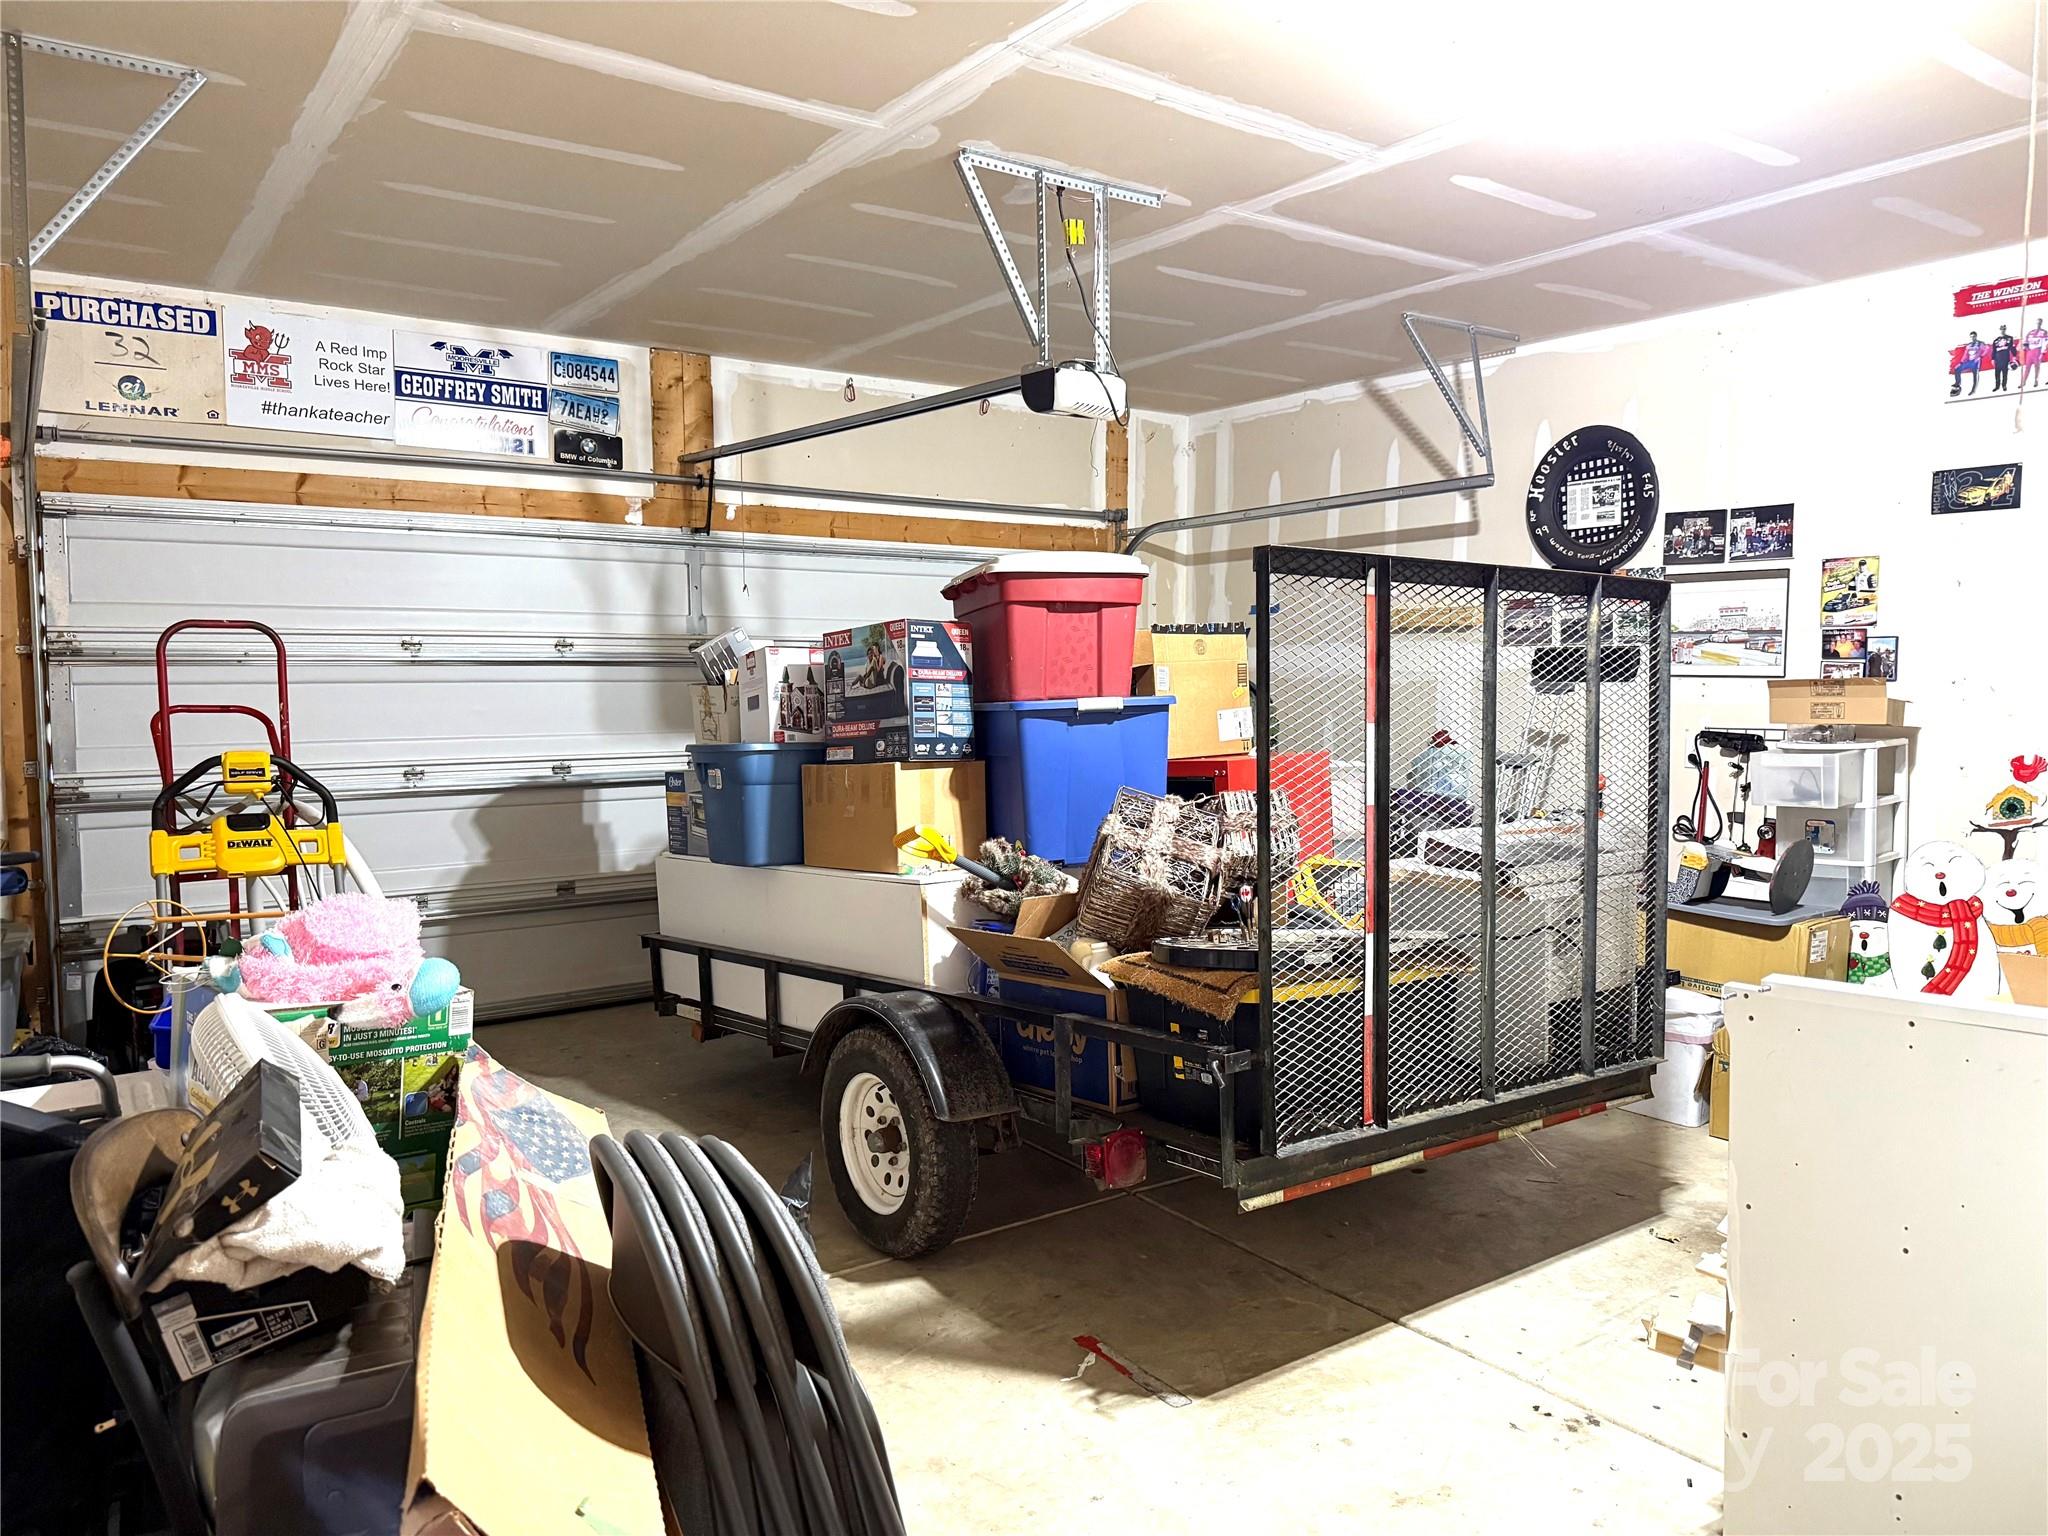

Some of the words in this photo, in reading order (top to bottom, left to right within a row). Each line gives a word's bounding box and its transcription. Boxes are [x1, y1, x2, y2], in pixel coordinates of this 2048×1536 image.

[1972, 290, 1992, 301] THE
[1993, 281, 2042, 297] WINSTON
[41, 294, 211, 334] PURCHASED
[105, 331, 161, 365] 32
[315, 341, 326, 353] A
[330, 342, 358, 356] Red
[362, 346, 387, 361] Imp
[243, 361, 280, 376] MMS
[319, 358, 353, 373] Rock
[358, 363, 385, 376] Star
[447, 354, 498, 366] MOORESVILLE
[314, 375, 350, 389] Lives
[354, 379, 391, 393] Here!
[401, 374, 486, 402] GEOFFREY
[490, 384, 543, 409] SMITH
[85, 400, 180, 418] LENNAR
[261, 401, 390, 425] #thankateacher
[560, 452, 577, 460] BMW
[587, 456, 617, 466] Columbia
[1528, 435, 1579, 502] Hoosier
[1641, 472, 1655, 499] F-45
[1932, 472, 1942, 514] MICHAEL
[1549, 537, 1574, 557] WORLD
[910, 624, 934, 633] INTEX
[951, 627, 969, 636] QUEEN
[824, 632, 850, 648] INTEX
[832, 725, 858, 733] DURA-BEAM
[668, 776, 682, 788] Oster
[343, 1034, 352, 1042] IN
[353, 1031, 373, 1040] JUST
[373, 1030, 378, 1038] 3
[366, 1046, 404, 1058] MOSQUITO
[405, 1040, 447, 1053] PROTECTION
